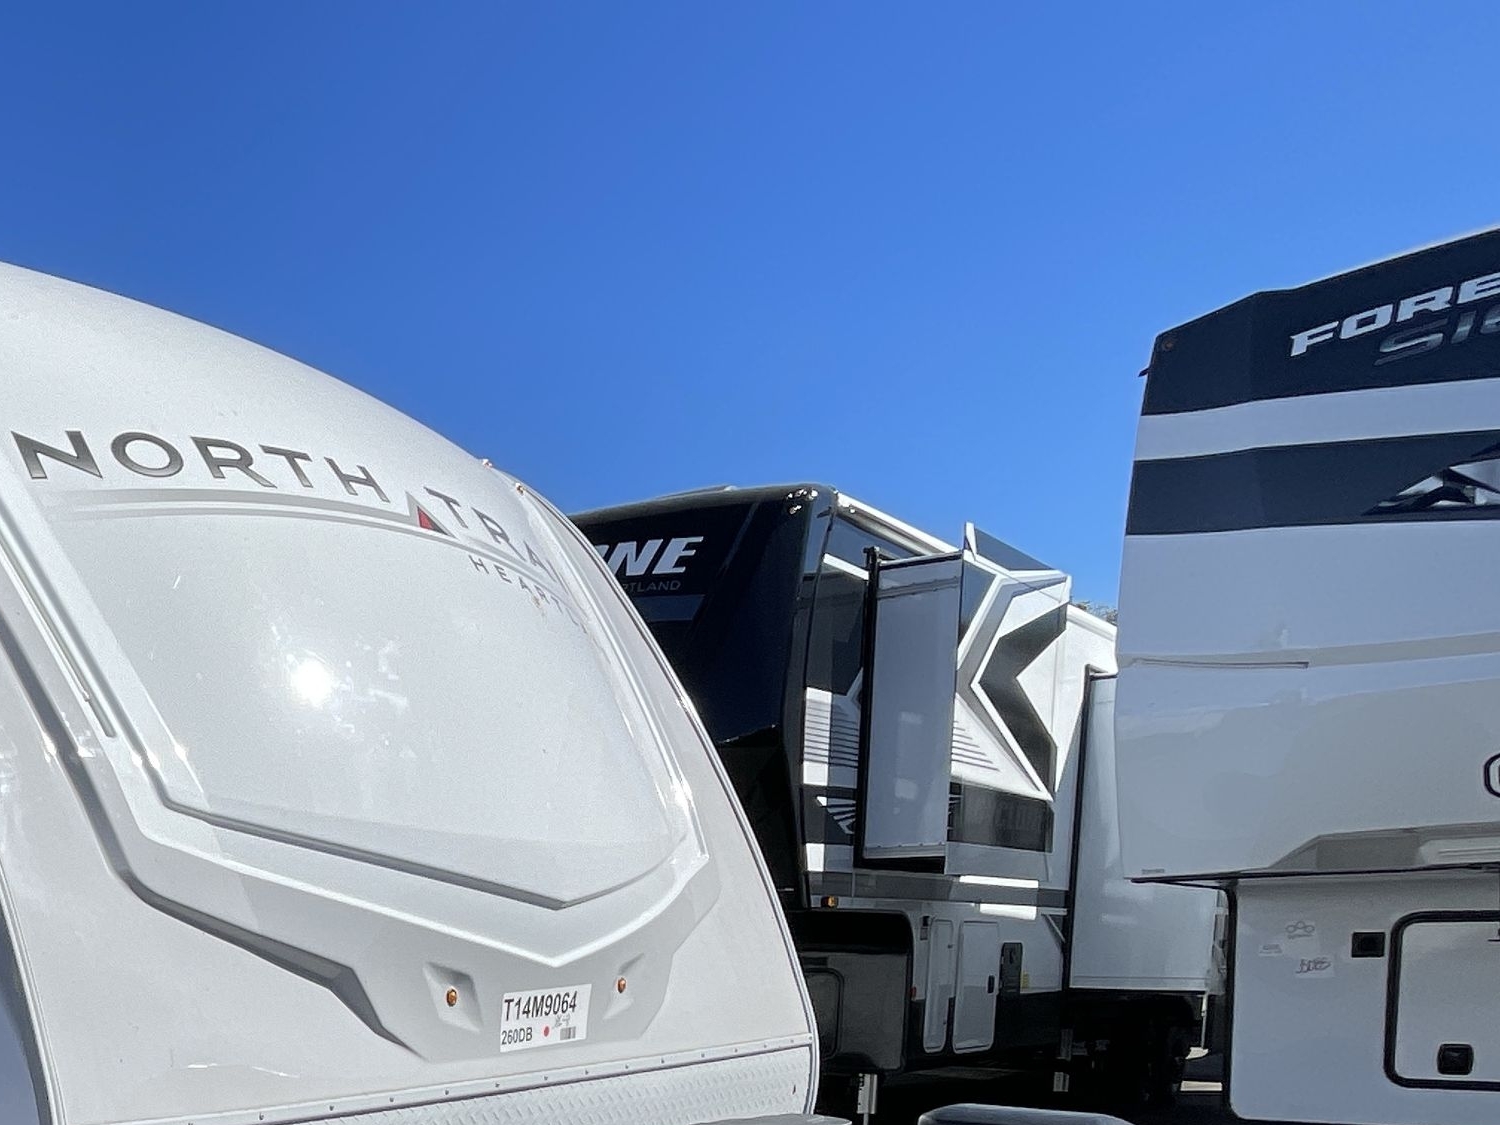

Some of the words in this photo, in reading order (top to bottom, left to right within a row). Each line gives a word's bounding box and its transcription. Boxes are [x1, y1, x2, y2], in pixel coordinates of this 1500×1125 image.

[1291, 272, 1500, 357] FORE
[11, 430, 391, 503] NORTH
[504, 990, 578, 1021] T14M9064
[501, 1026, 533, 1045] 260DB
